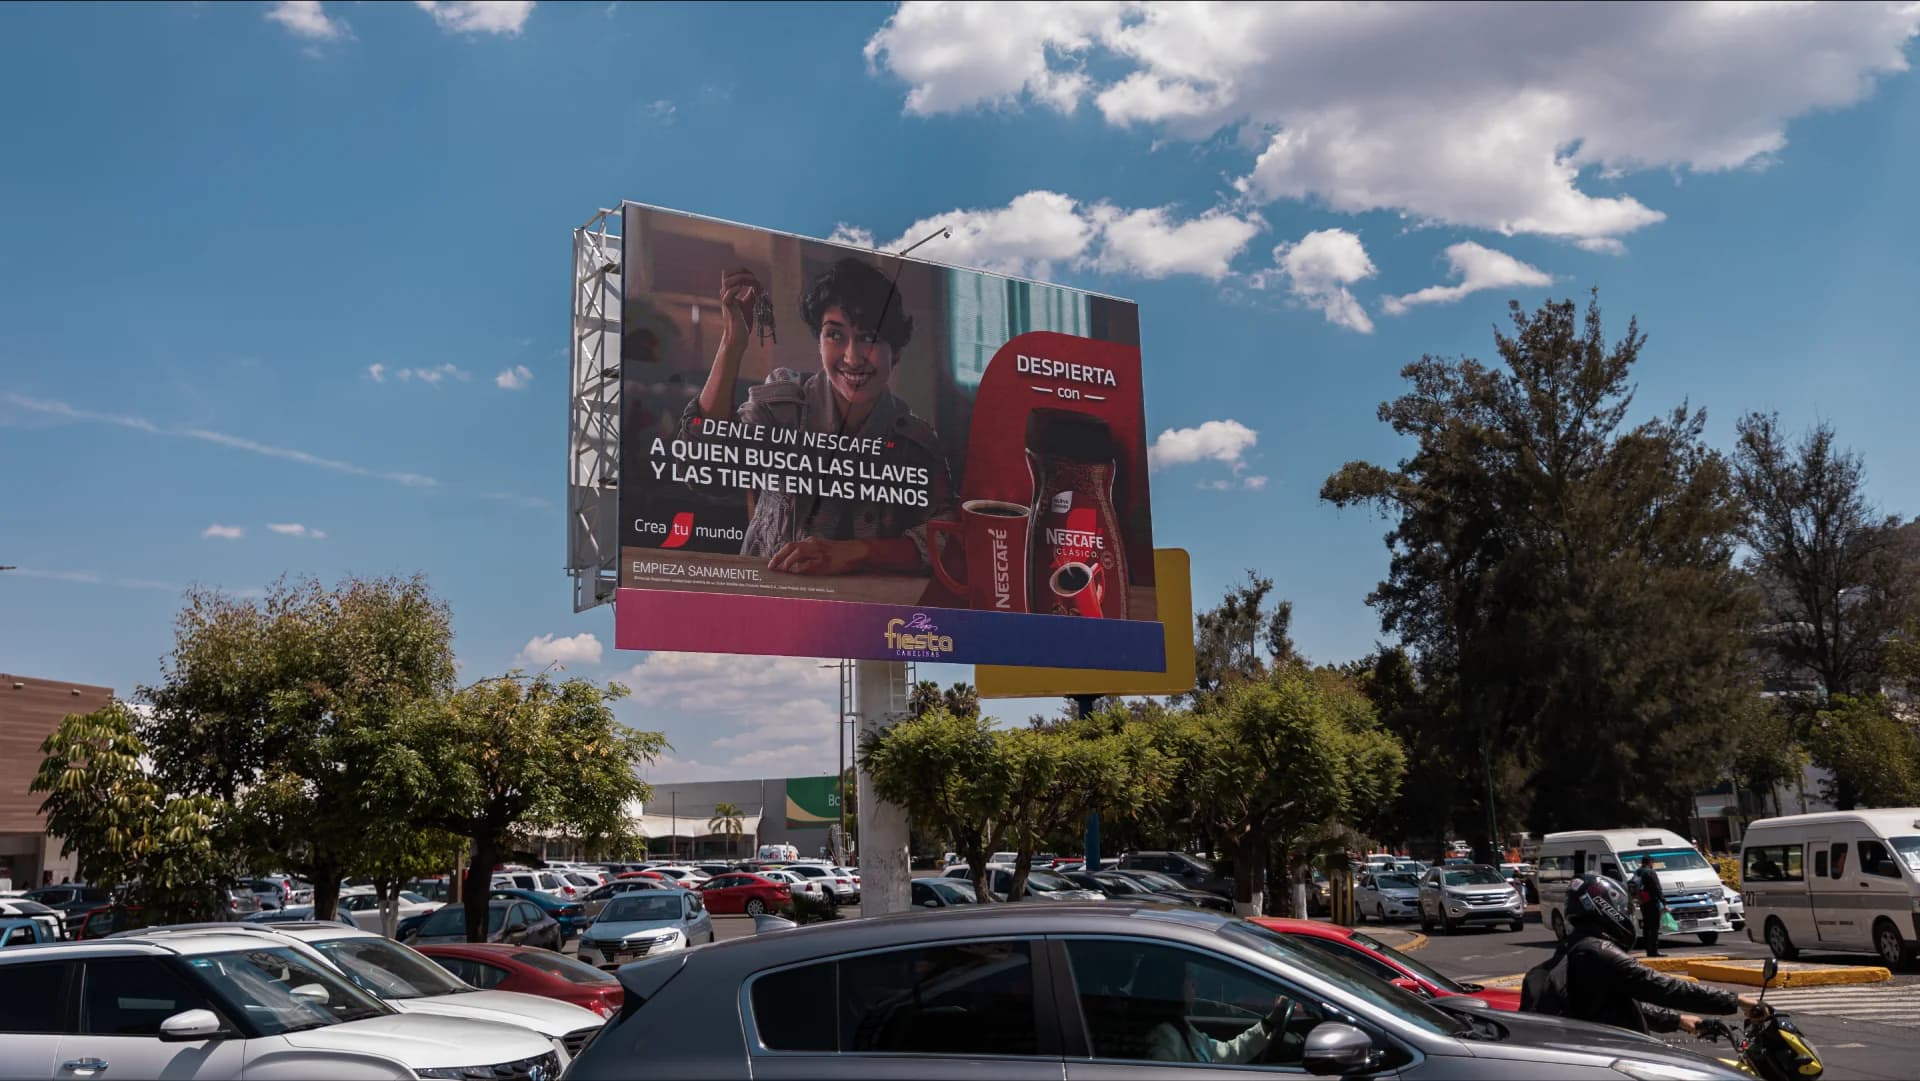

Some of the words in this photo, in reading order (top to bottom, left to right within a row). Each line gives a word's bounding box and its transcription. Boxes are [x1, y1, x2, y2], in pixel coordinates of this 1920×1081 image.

[1016, 354, 1117, 387] DESPIERTA
[1057, 387, 1080, 400] con
[771, 426, 797, 445] UN
[650, 437, 666, 456] A
[671, 439, 739, 464] QUIEN
[745, 447, 813, 473] BUSCA
[818, 456, 855, 477] LAS
[859, 461, 929, 486] LLAVES
[650, 460, 667, 480] Y
[672, 463, 713, 485] LAS
[716, 468, 780, 491] TIENE
[785, 475, 813, 495] EN
[818, 479, 855, 499] LAS
[860, 483, 929, 507] MANOS
[634, 518, 667, 534] Crea
[673, 522, 689, 536] tu
[695, 526, 744, 541] mundo
[632, 561, 686, 576] EMPIEZA
[687, 565, 763, 582] SANAMENTE.
[987, 528, 1011, 609] NESCAFÉ
[884, 618, 953, 652] fiesta
